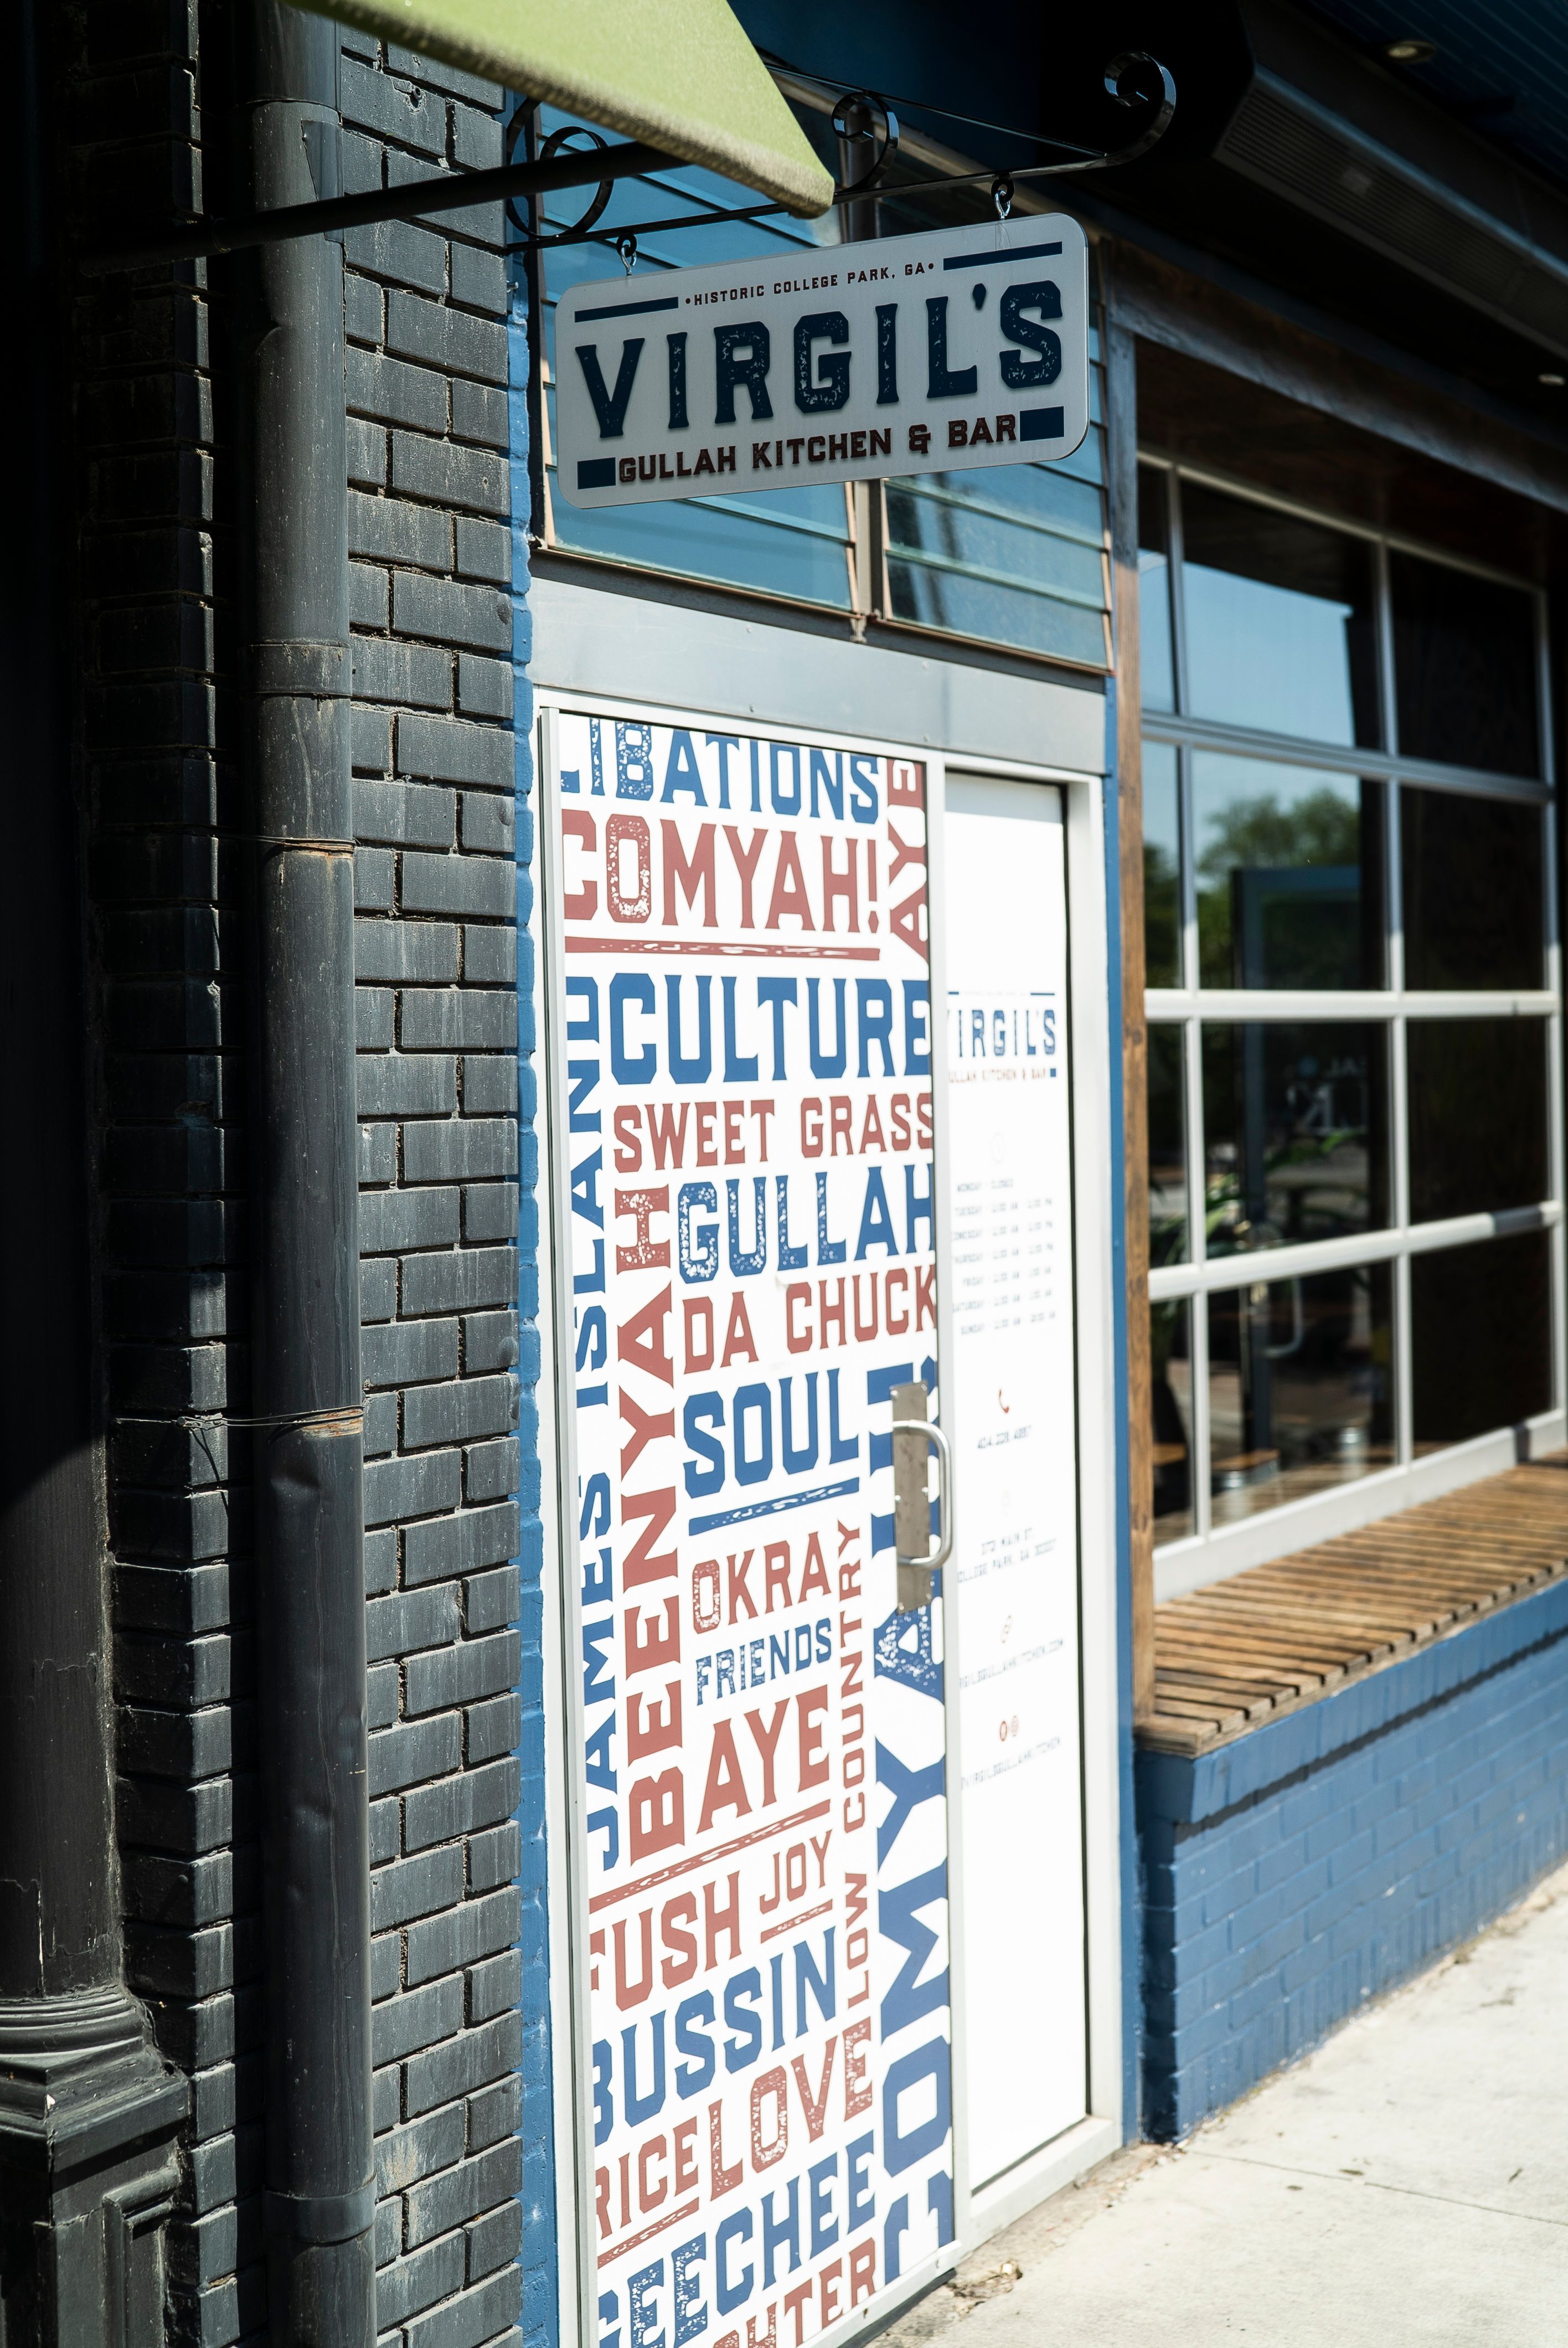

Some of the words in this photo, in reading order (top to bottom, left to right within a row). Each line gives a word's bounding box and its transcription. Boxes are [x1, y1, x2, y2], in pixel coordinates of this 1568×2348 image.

[694, 285, 765, 306] HISTORIC
[773, 275, 838, 295] COLLEGE
[847, 267, 895, 285] PARK,
[905, 262, 925, 276] GA
[575, 280, 1062, 438] VIRGIL'S
[619, 445, 736, 482] GULLAH
[752, 428, 891, 469] KITCHEN
[909, 424, 931, 454] &
[947, 414, 1017, 448] BAR
[561, 809, 879, 934] COMYAH!
[609, 972, 931, 1085] CULTURE
[947, 1010, 1055, 1057] IRGIL'S
[613, 1099, 776, 1173] SWEET
[801, 1093, 933, 1158] GRASS
[678, 1163, 935, 1284] GULLAH
[683, 1291, 759, 1374] DA
[786, 1264, 936, 1353] CHUCK
[683, 1368, 859, 1499] SOUL
[614, 1183, 685, 1866] BEENYAH
[692, 1531, 832, 1634] OKRA
[695, 1618, 832, 1706] FRIENDS
[838, 1520, 865, 1834] COUNTRY
[697, 1684, 829, 1834] AYE
[760, 1829, 832, 1914] JOY
[845, 1872, 869, 2009] LOW
[709, 2016, 872, 2202] LOVE
